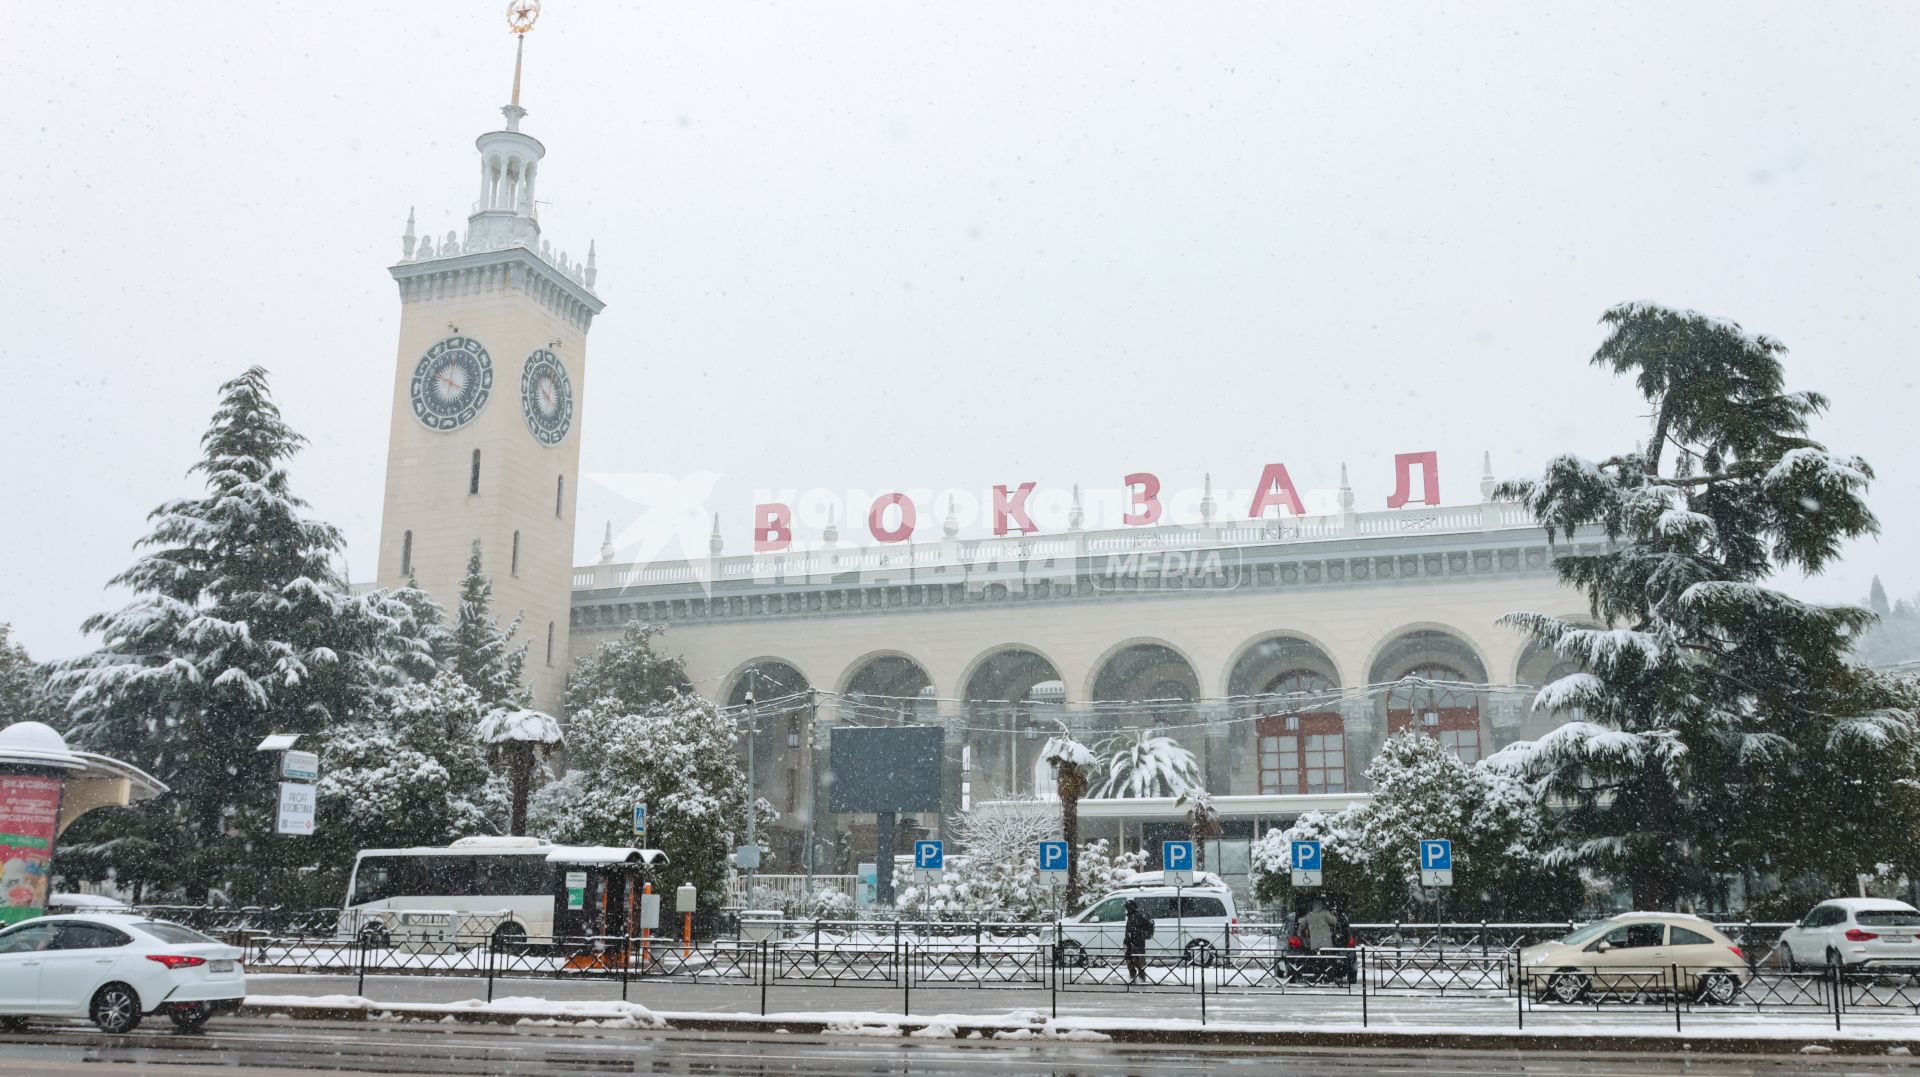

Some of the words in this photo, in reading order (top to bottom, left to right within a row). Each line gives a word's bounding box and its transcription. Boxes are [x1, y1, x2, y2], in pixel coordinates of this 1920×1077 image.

[754, 451, 1440, 552] ВОКЗАЛ
[921, 844, 938, 866] P
[1046, 844, 1062, 867] P
[1170, 844, 1187, 867] P
[1298, 844, 1315, 867] P
[1427, 844, 1444, 867] P
